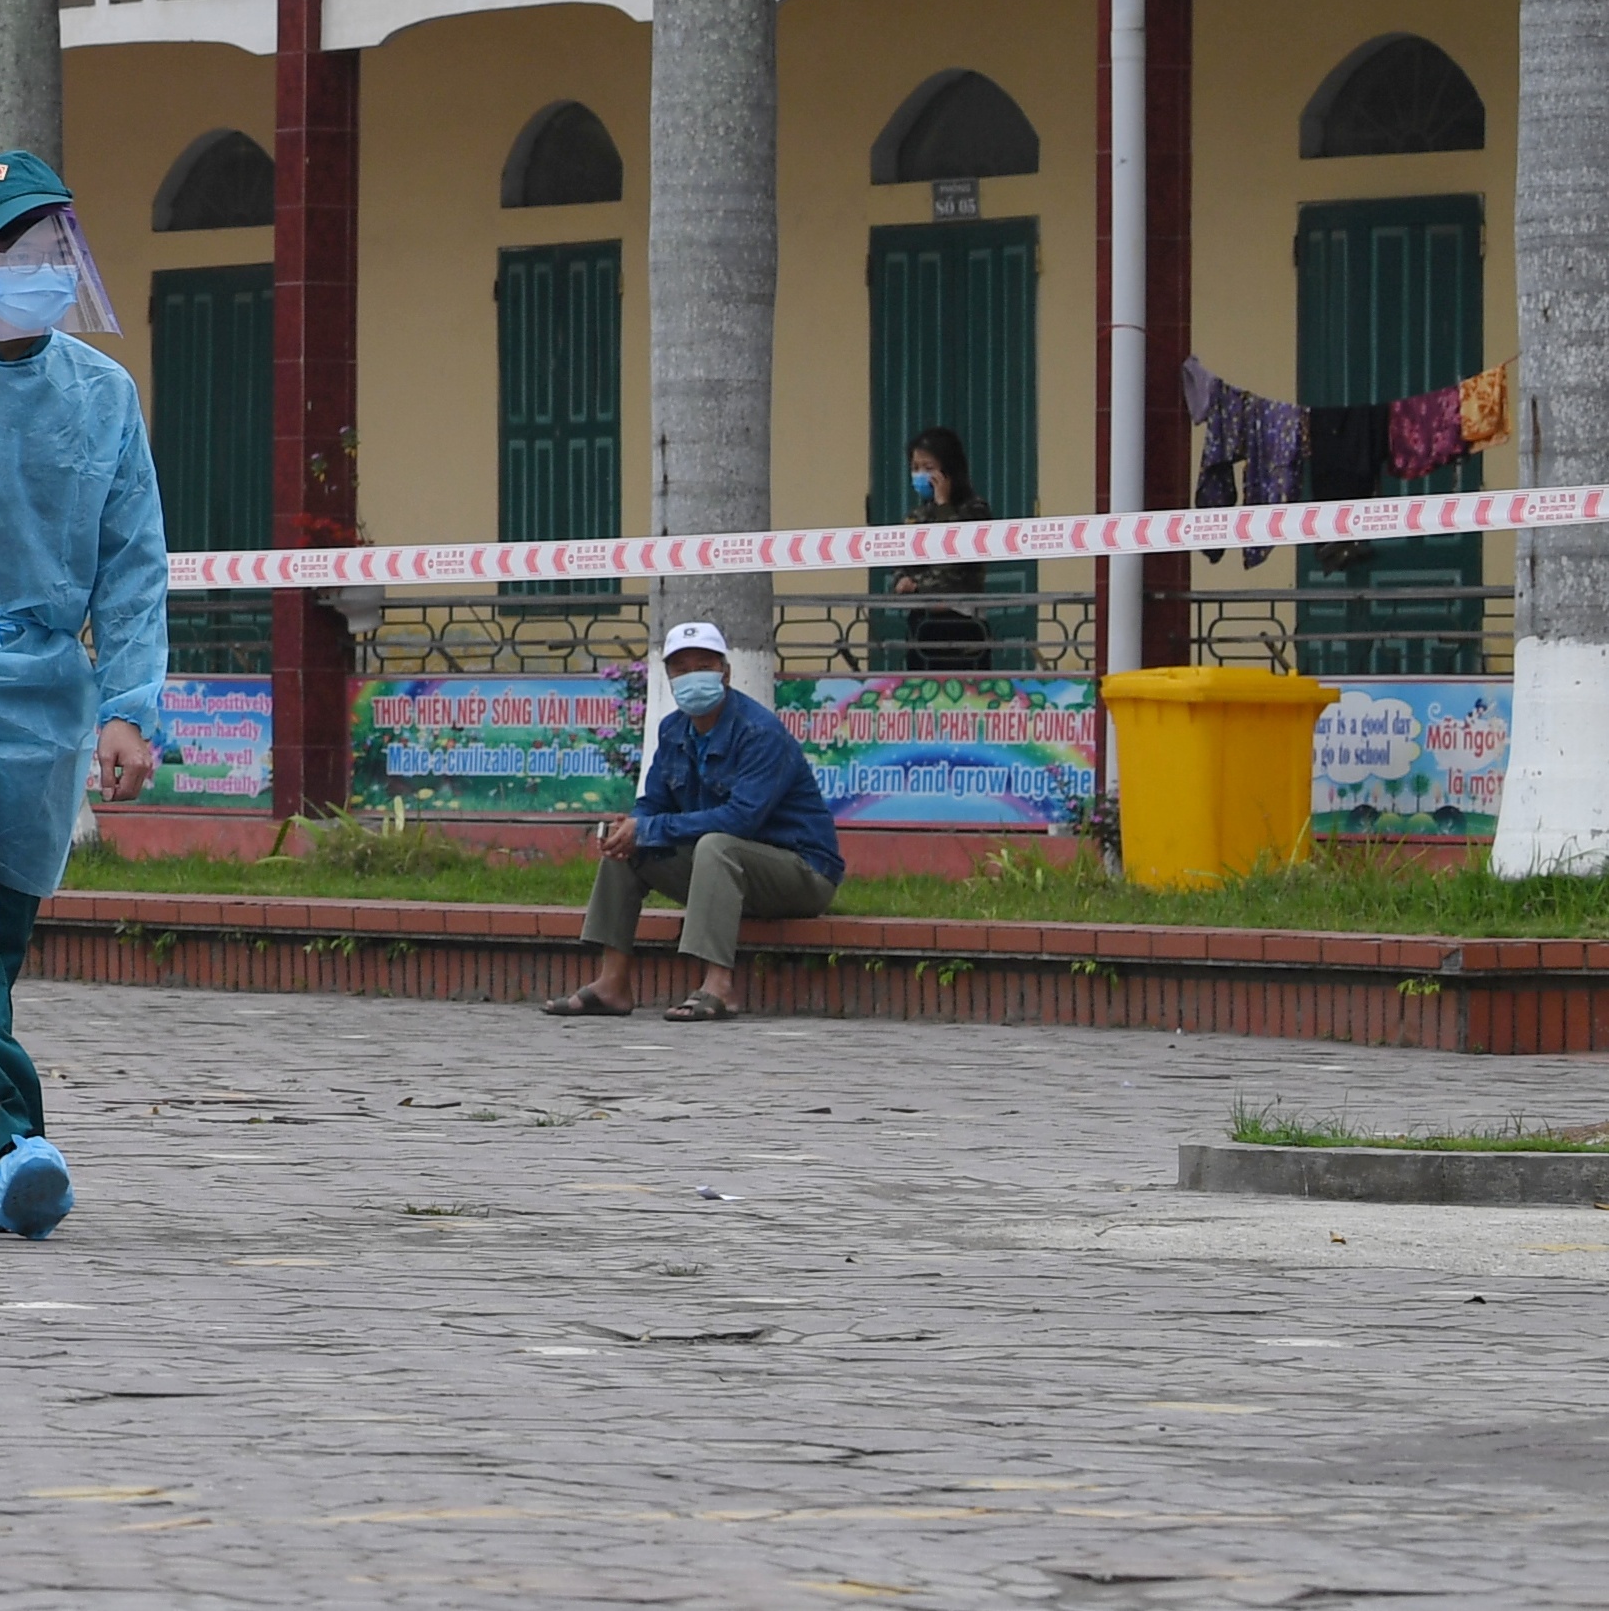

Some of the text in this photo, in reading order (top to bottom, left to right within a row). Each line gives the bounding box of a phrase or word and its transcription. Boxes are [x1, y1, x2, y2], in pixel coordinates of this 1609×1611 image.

[162, 692, 272, 714] Think positively
[372, 694, 412, 733] THỰC
[416, 690, 452, 734] HIỆN
[455, 687, 487, 727] NẾP
[491, 686, 532, 727] SỐNG
[537, 690, 570, 726] VĂN
[175, 717, 260, 742] Learn hardly
[848, 710, 873, 741] VUI
[877, 708, 914, 742] CHƠI
[916, 704, 935, 742] VÀ
[939, 704, 980, 742] PHÁT
[983, 695, 1029, 743] TRIỂN
[1033, 703, 1077, 742] CÙNG
[1336, 709, 1346, 735] is
[1350, 717, 1358, 735] a
[1361, 709, 1389, 741] good
[1392, 709, 1411, 743] day
[1426, 716, 1458, 750] Mỗi
[183, 746, 253, 765] Work well
[387, 744, 430, 775] Make
[432, 749, 444, 774] a
[447, 743, 524, 775] civilizable
[527, 741, 558, 775] and
[1321, 743, 1335, 769] go
[1339, 742, 1351, 765] to
[1355, 740, 1390, 765] school
[175, 774, 259, 797] Live usefully
[849, 761, 905, 794] learn
[910, 761, 950, 794] and
[952, 766, 1009, 799] grow
[1448, 766, 1464, 795] là
